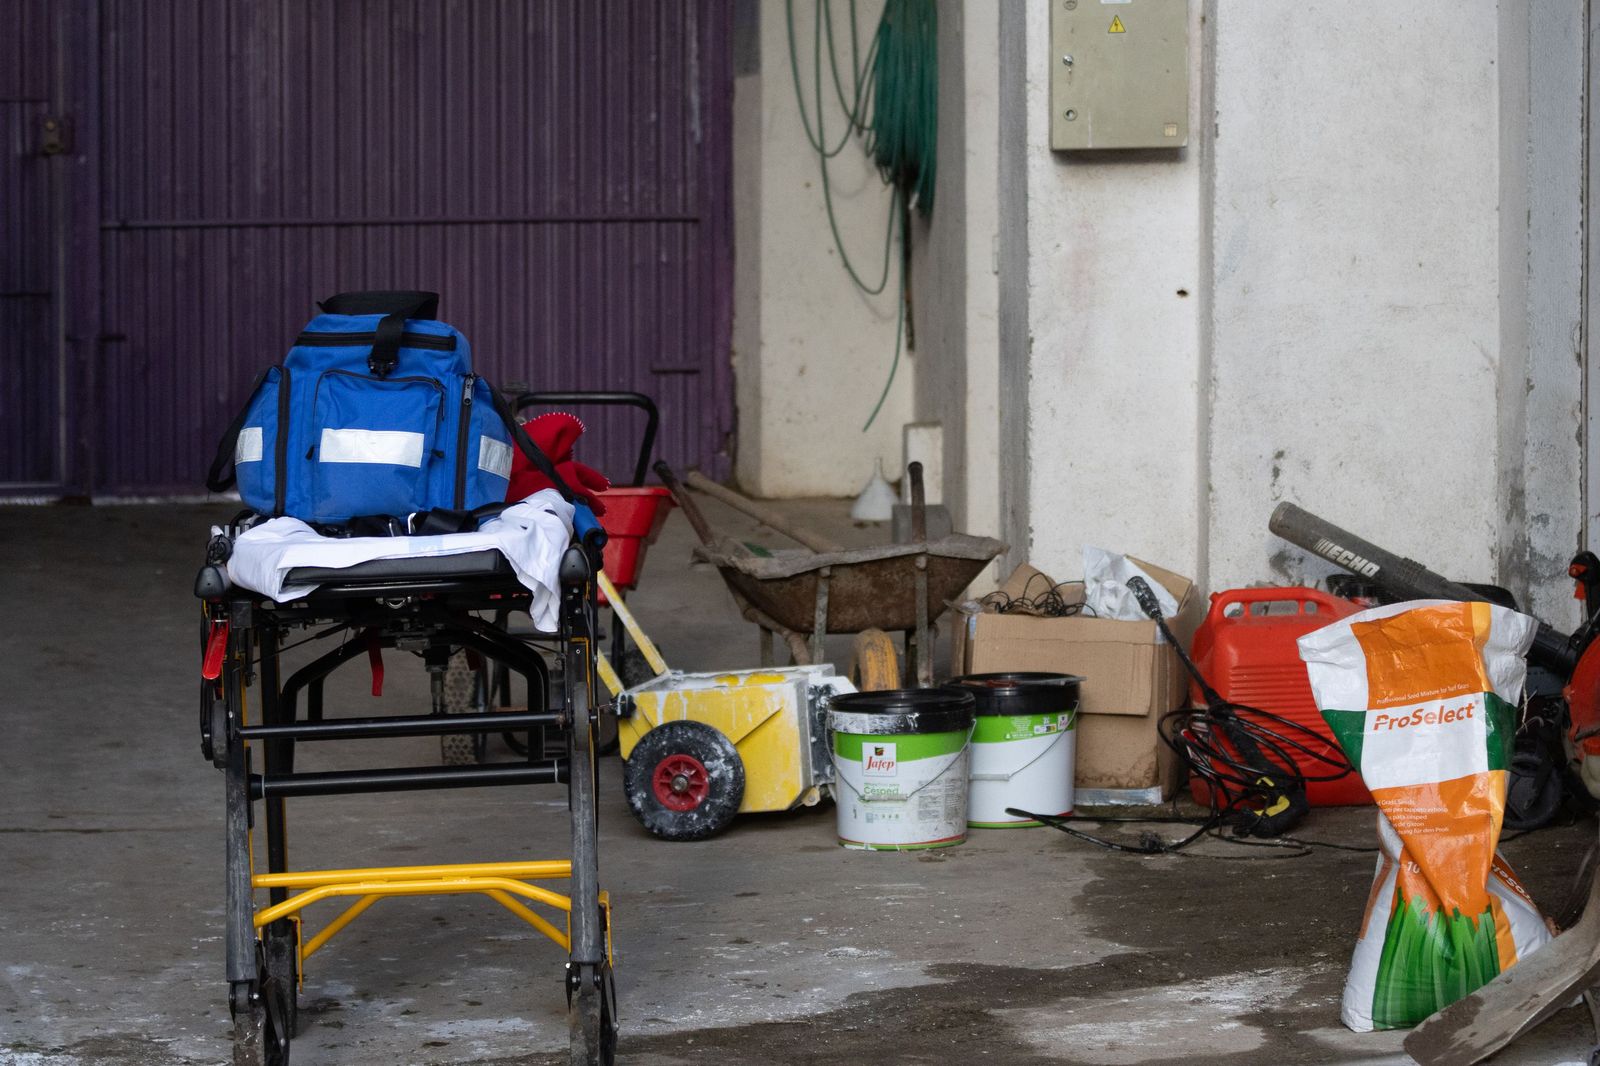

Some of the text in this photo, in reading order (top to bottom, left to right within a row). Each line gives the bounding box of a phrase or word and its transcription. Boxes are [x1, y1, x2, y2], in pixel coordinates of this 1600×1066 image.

[1326, 543, 1380, 578] ECHO
[1420, 689, 1440, 698] Mixture
[1373, 702, 1475, 731] ProSelect
[865, 756, 894, 771] Jafep
